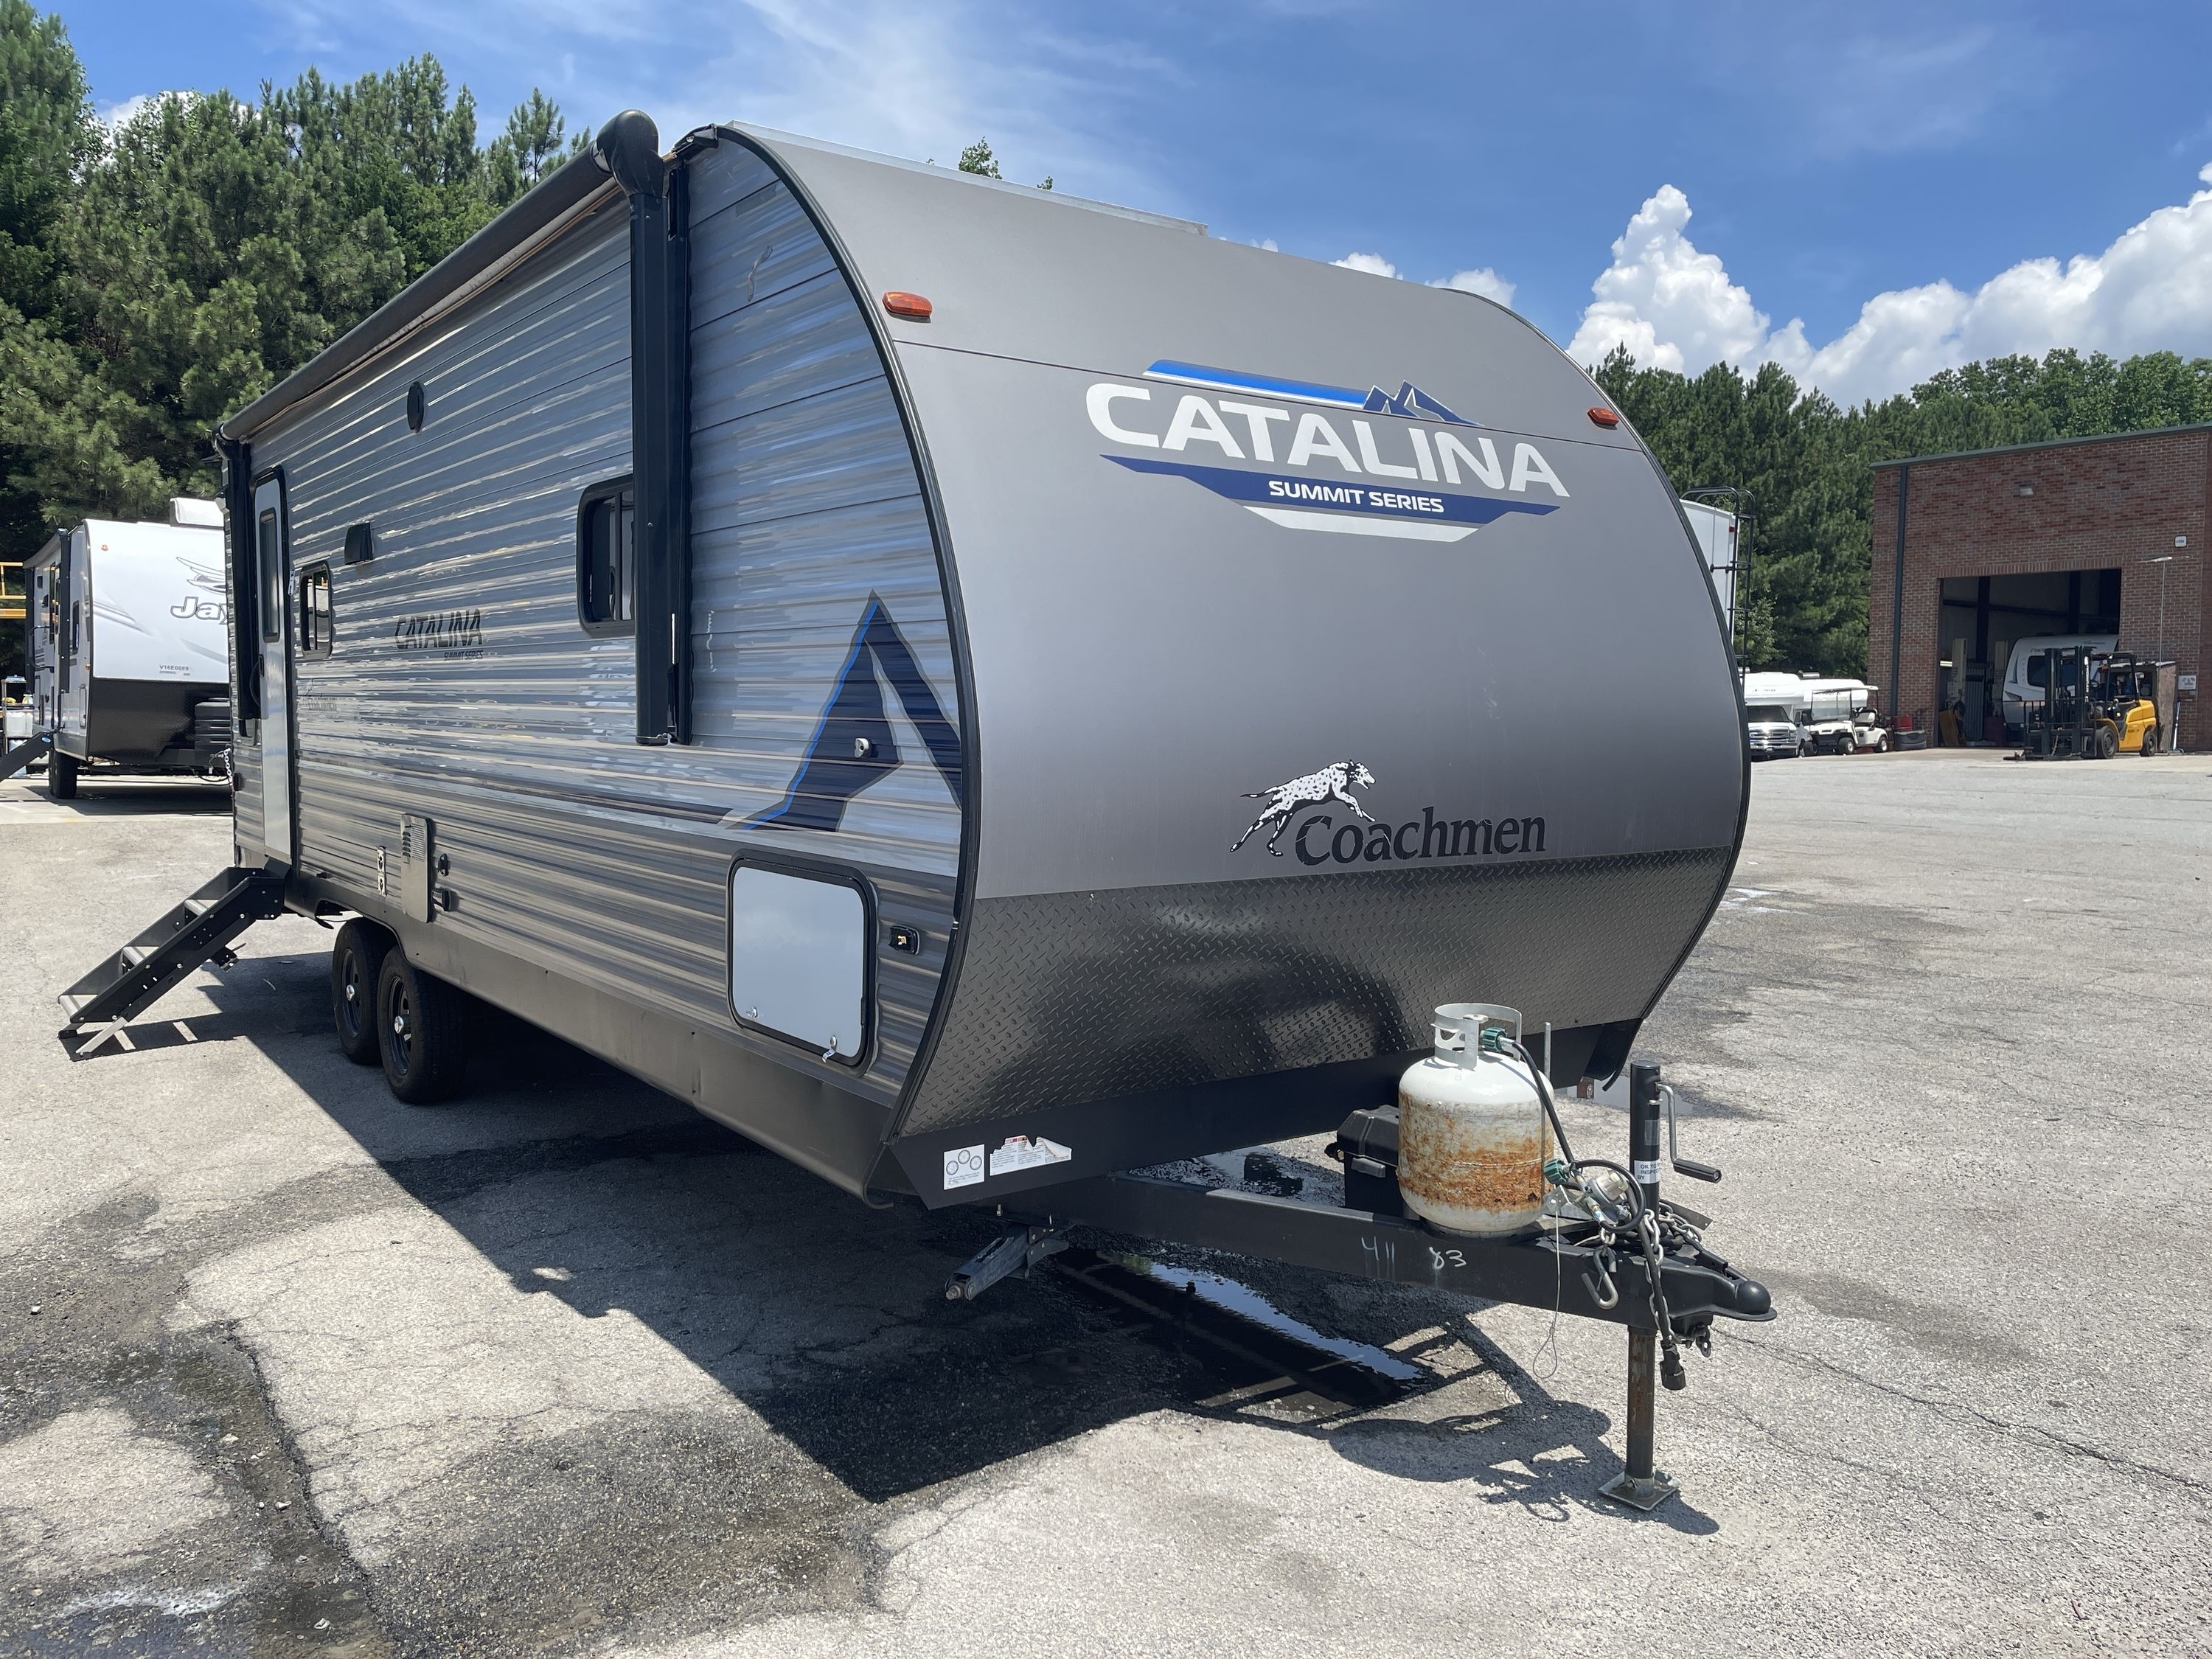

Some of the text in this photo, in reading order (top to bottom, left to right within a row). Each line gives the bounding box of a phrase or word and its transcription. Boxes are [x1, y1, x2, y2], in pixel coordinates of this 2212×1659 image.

[1085, 383, 1571, 498] CATALINA
[1268, 480, 1444, 513] SUMMIT SERIES
[395, 608, 482, 649] CATALINA
[1295, 806, 1546, 866] Coachmen
